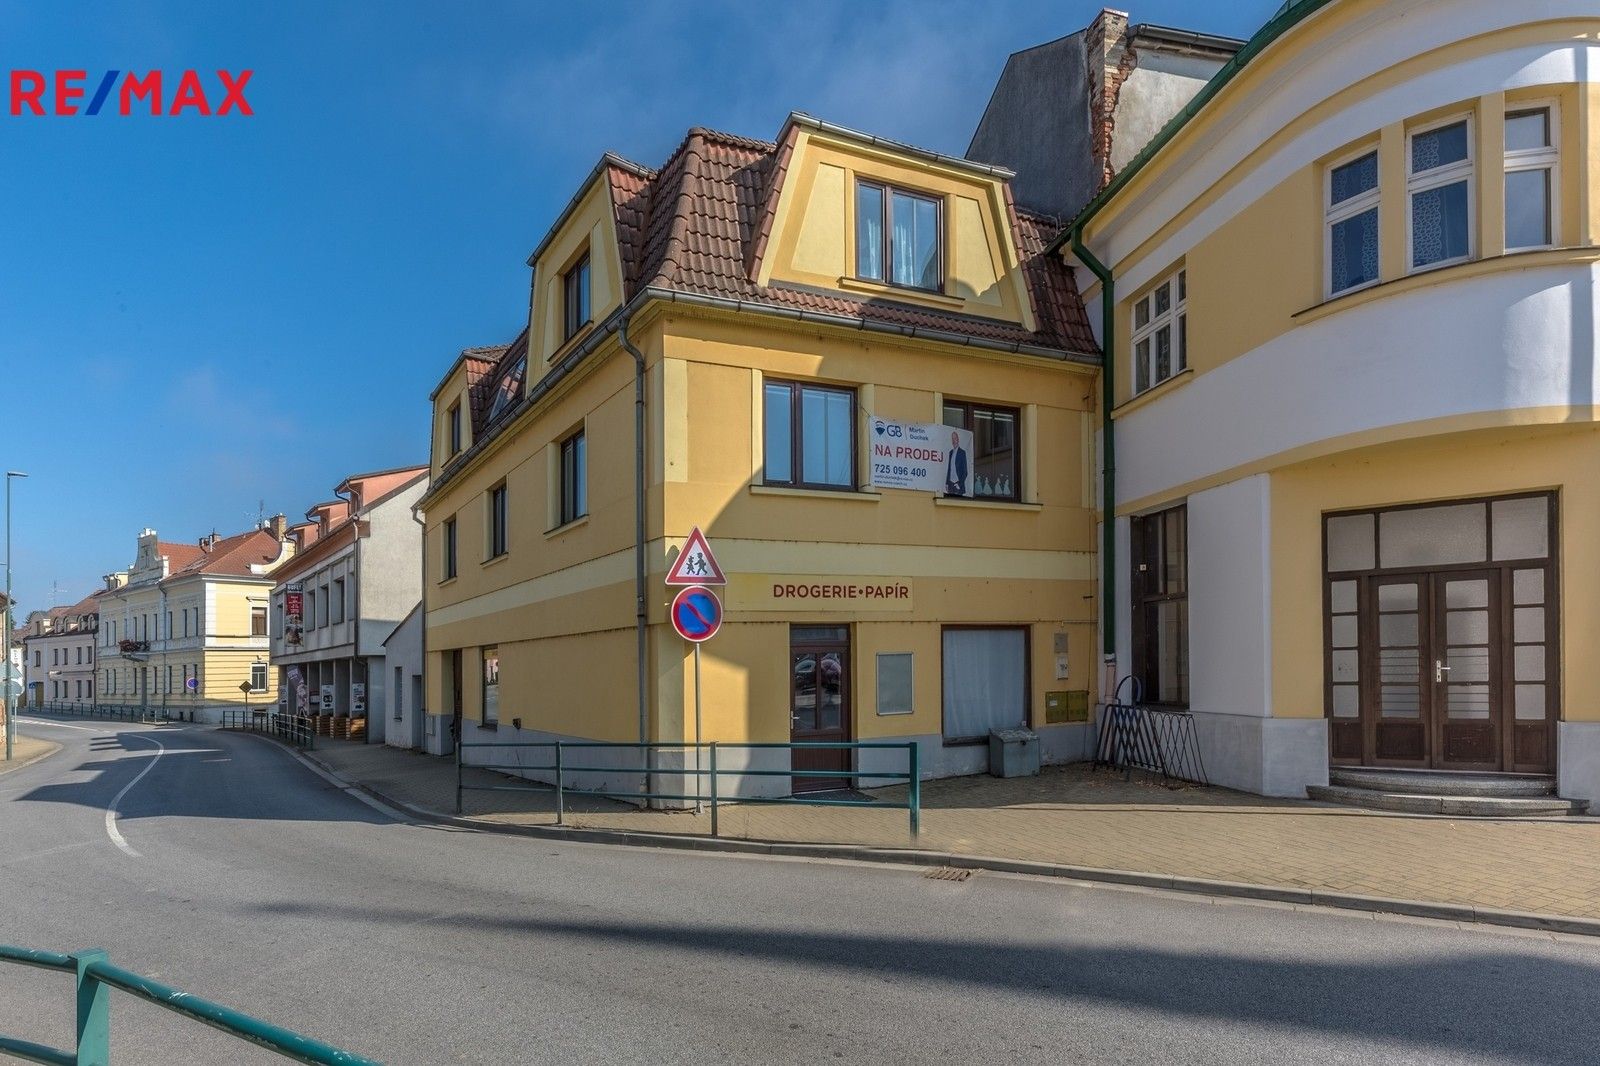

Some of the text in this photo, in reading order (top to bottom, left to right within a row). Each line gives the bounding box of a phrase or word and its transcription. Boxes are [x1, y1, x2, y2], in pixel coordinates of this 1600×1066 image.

[875, 444, 943, 462] NA PRODEJ
[875, 464, 926, 477] 725 096 400
